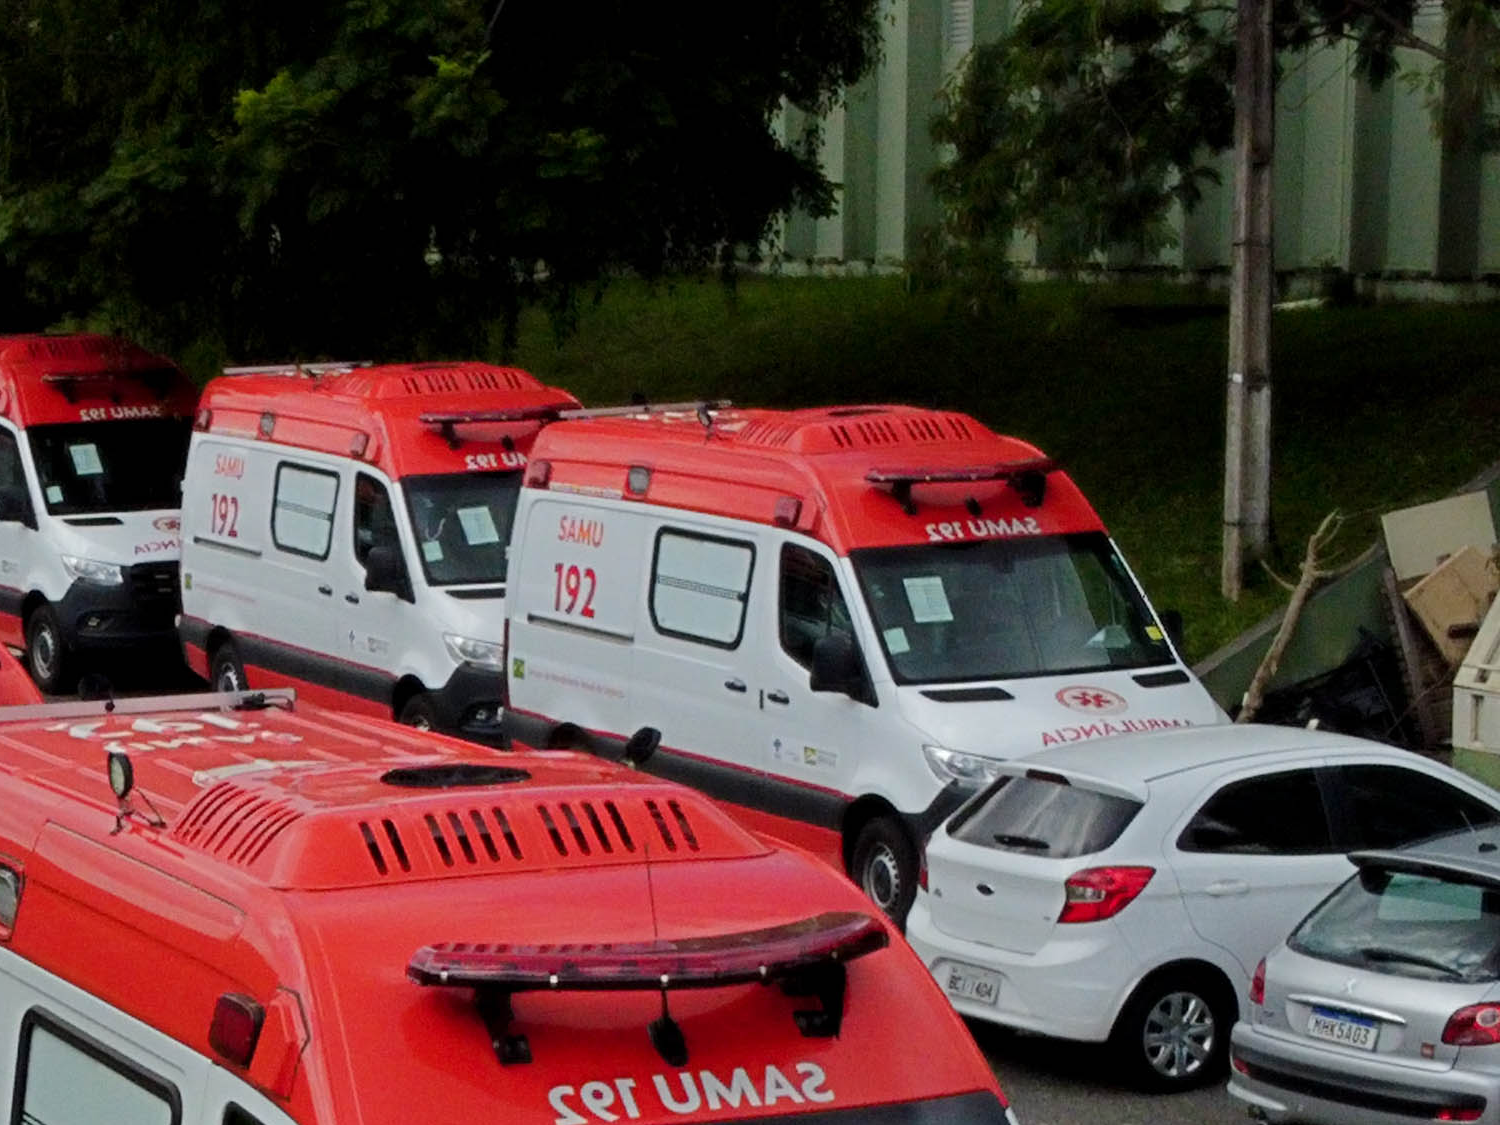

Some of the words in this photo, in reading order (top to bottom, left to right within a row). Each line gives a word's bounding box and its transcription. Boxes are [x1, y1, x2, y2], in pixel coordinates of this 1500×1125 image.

[214, 454, 244, 480] SAMU
[212, 493, 238, 538] 192
[558, 514, 604, 549] SAMU
[555, 563, 596, 618] 192
